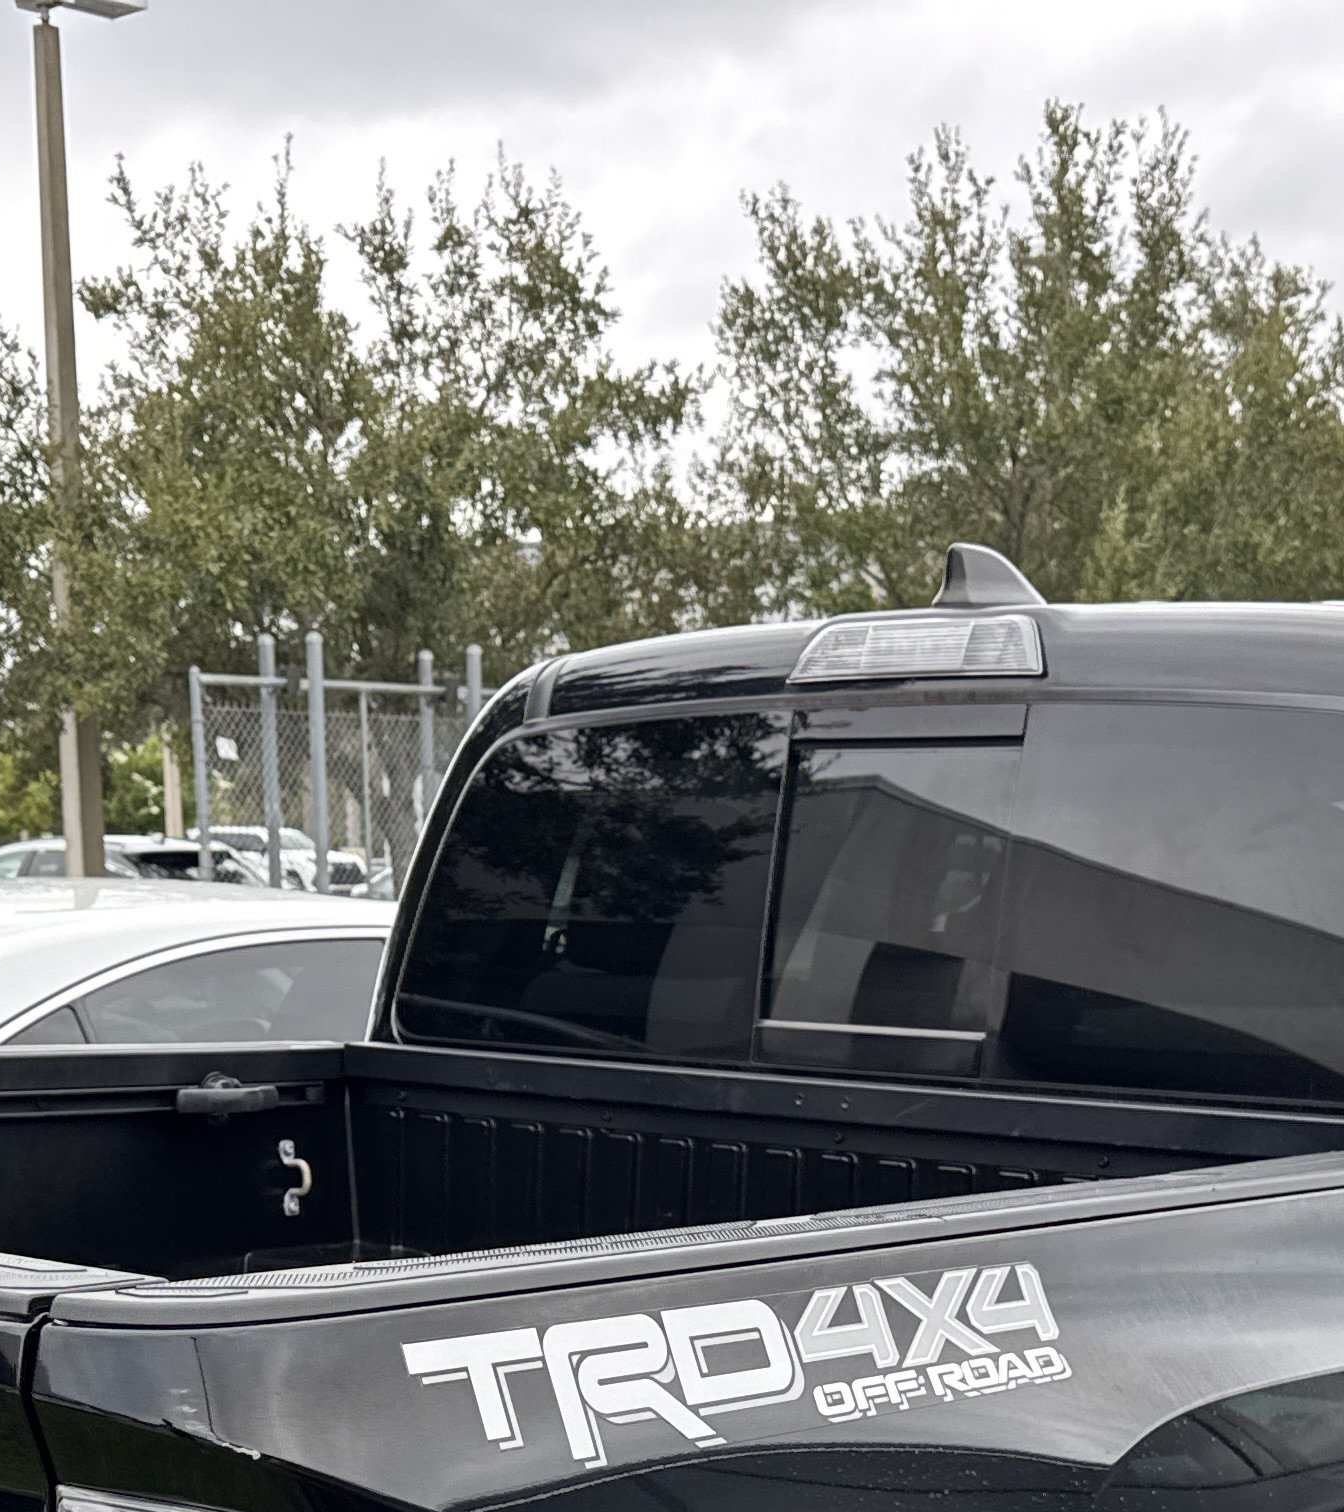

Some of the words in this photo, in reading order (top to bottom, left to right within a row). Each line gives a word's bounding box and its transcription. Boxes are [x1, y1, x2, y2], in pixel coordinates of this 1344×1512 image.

[401, 1299, 805, 1469] TRD
[793, 1261, 1060, 1369] 4X4
[925, 1346, 1073, 1402] ROAD
